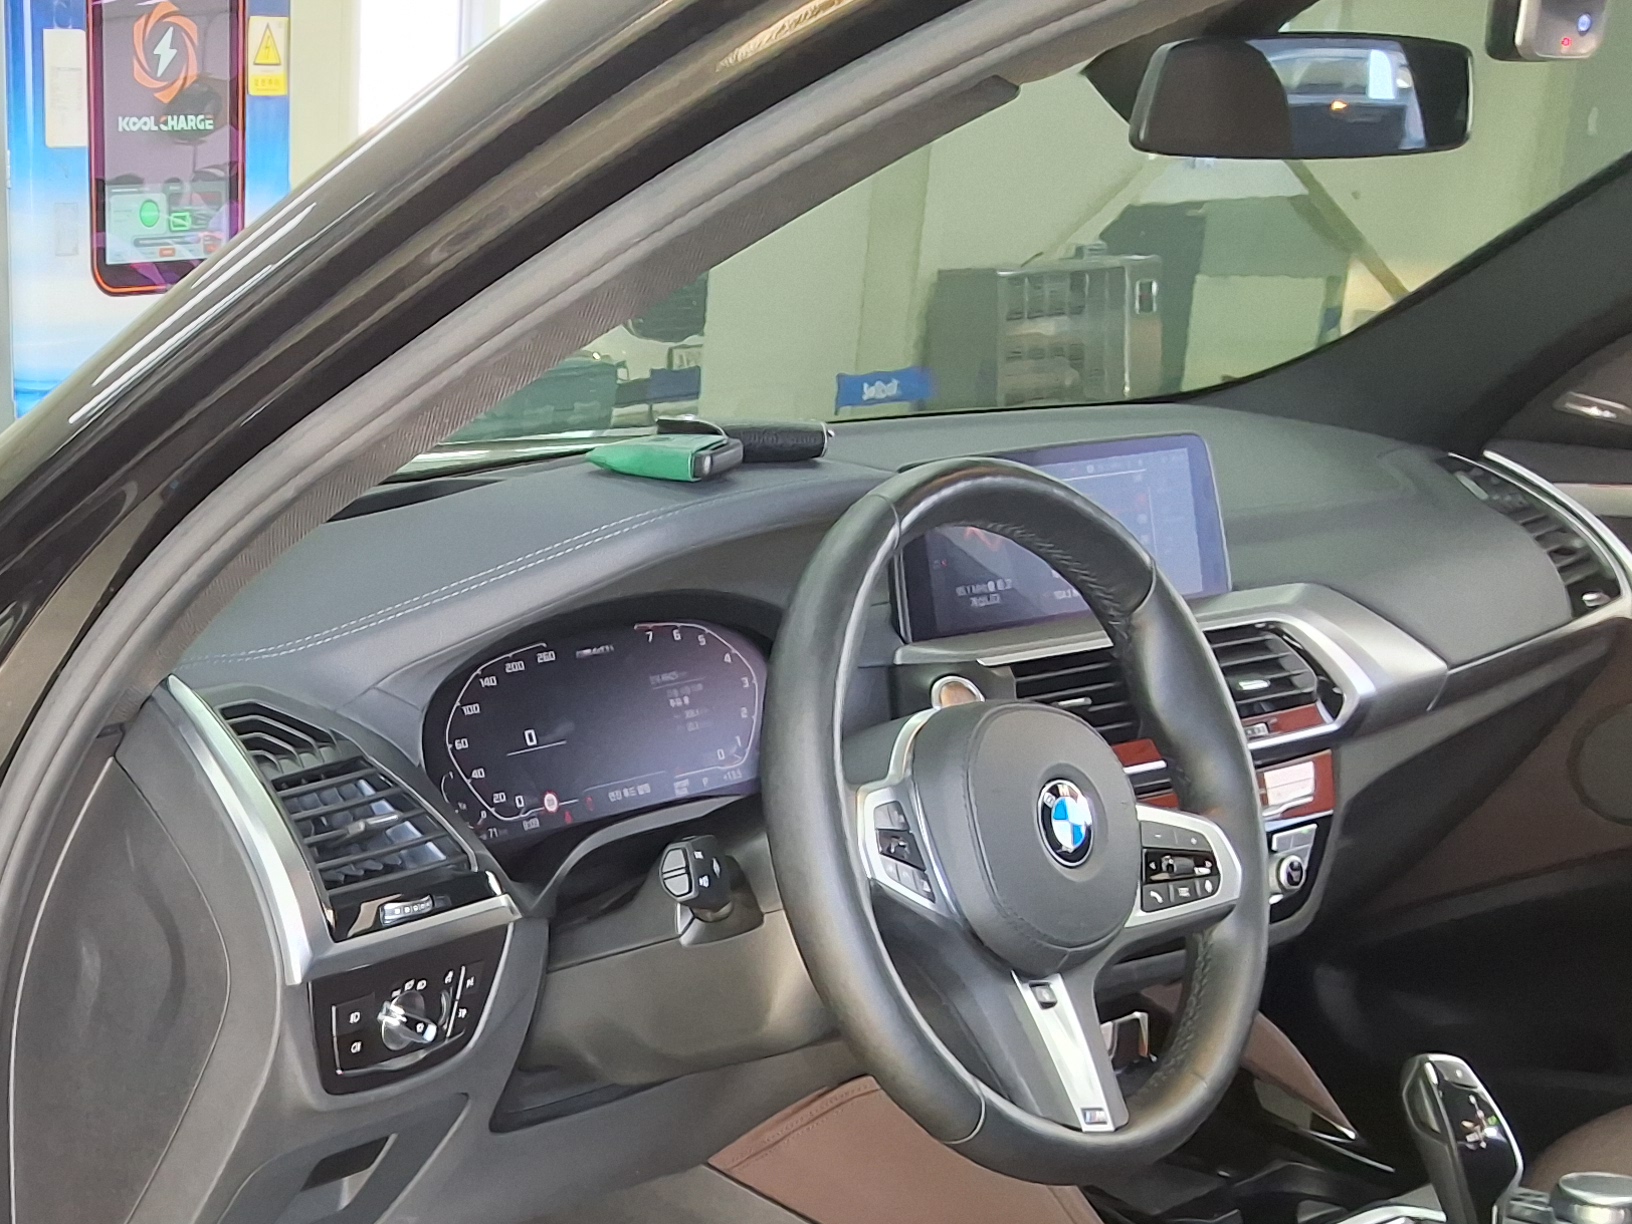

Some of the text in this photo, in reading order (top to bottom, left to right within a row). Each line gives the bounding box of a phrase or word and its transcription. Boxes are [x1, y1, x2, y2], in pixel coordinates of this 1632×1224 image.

[118, 114, 214, 131] KOOL CHARGE
[645, 631, 653, 643] 7
[672, 629, 682, 641] 6
[697, 635, 706, 646] 5
[536, 650, 556, 663] 260
[724, 653, 732, 664] 4
[505, 661, 525, 673] 200
[479, 676, 497, 687] 140
[741, 677, 749, 688] 3
[462, 703, 480, 715] 100
[740, 707, 748, 718] 2
[524, 729, 538, 746] 0
[735, 735, 742, 747] 1
[455, 738, 468, 750] 60
[717, 748, 725, 760] 0
[472, 767, 485, 779] 40
[492, 792, 506, 804] 20
[515, 795, 524, 808] 0
